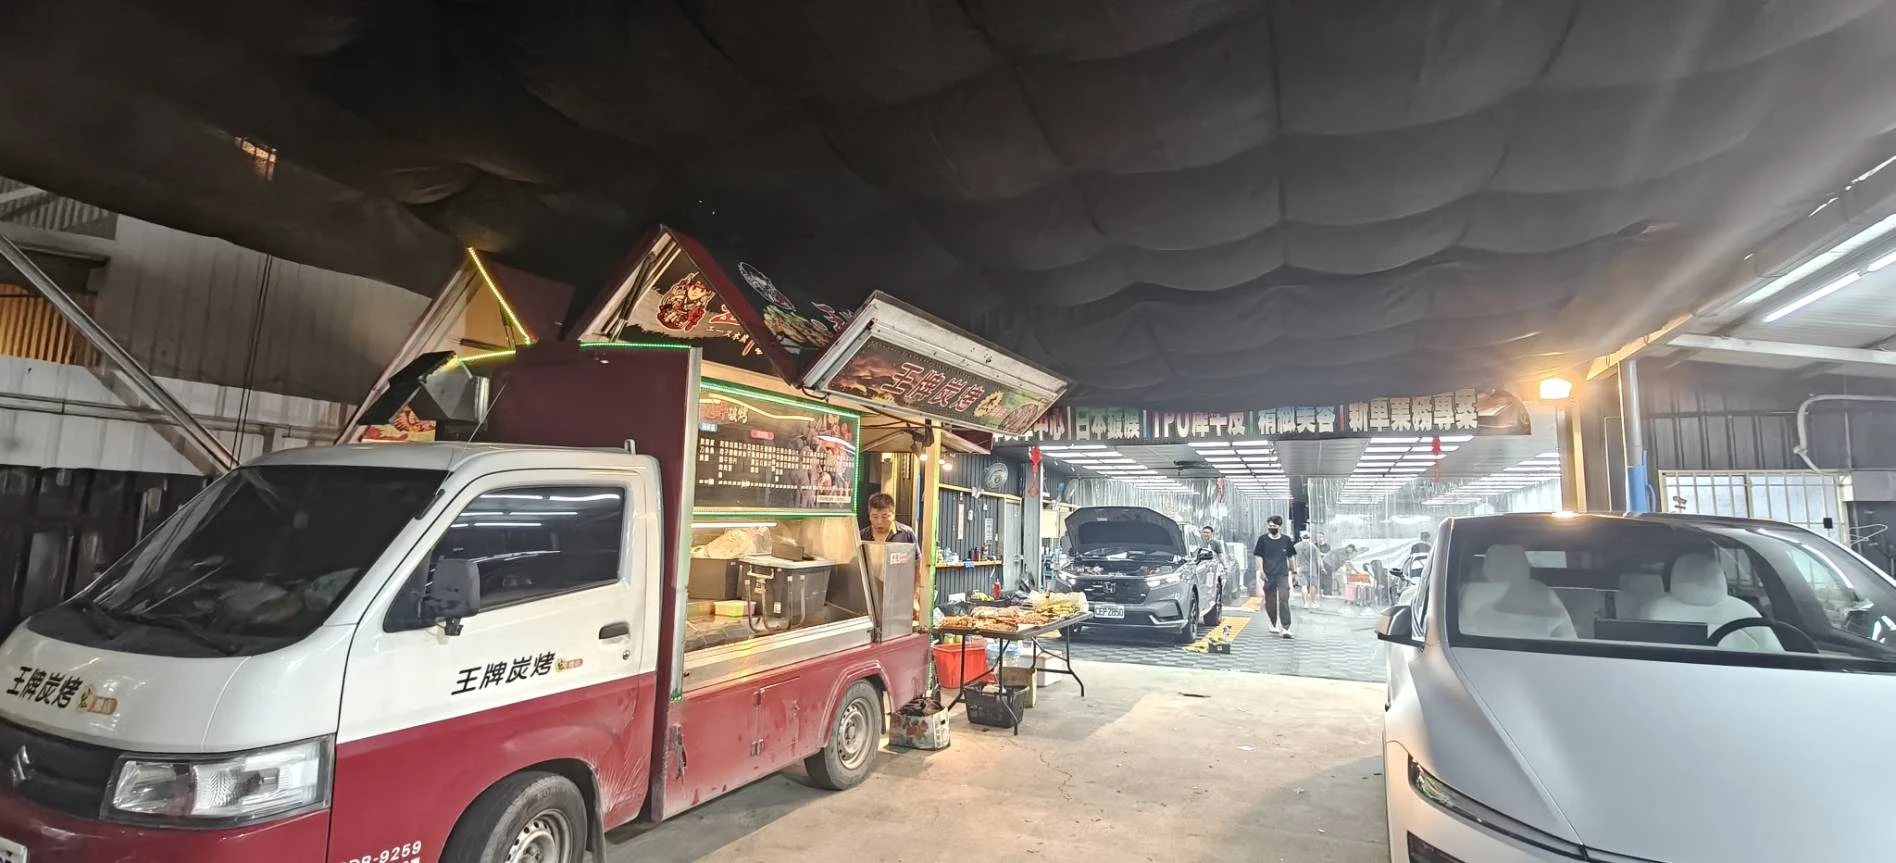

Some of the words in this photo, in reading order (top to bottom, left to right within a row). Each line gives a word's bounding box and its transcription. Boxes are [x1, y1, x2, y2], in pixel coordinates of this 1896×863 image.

[880, 362, 985, 412] 王牌炭烤
[1348, 389, 1478, 432] 新車業務專案
[6, 666, 83, 708] 王牌炭烤
[451, 651, 555, 695] 王牌炭烤
